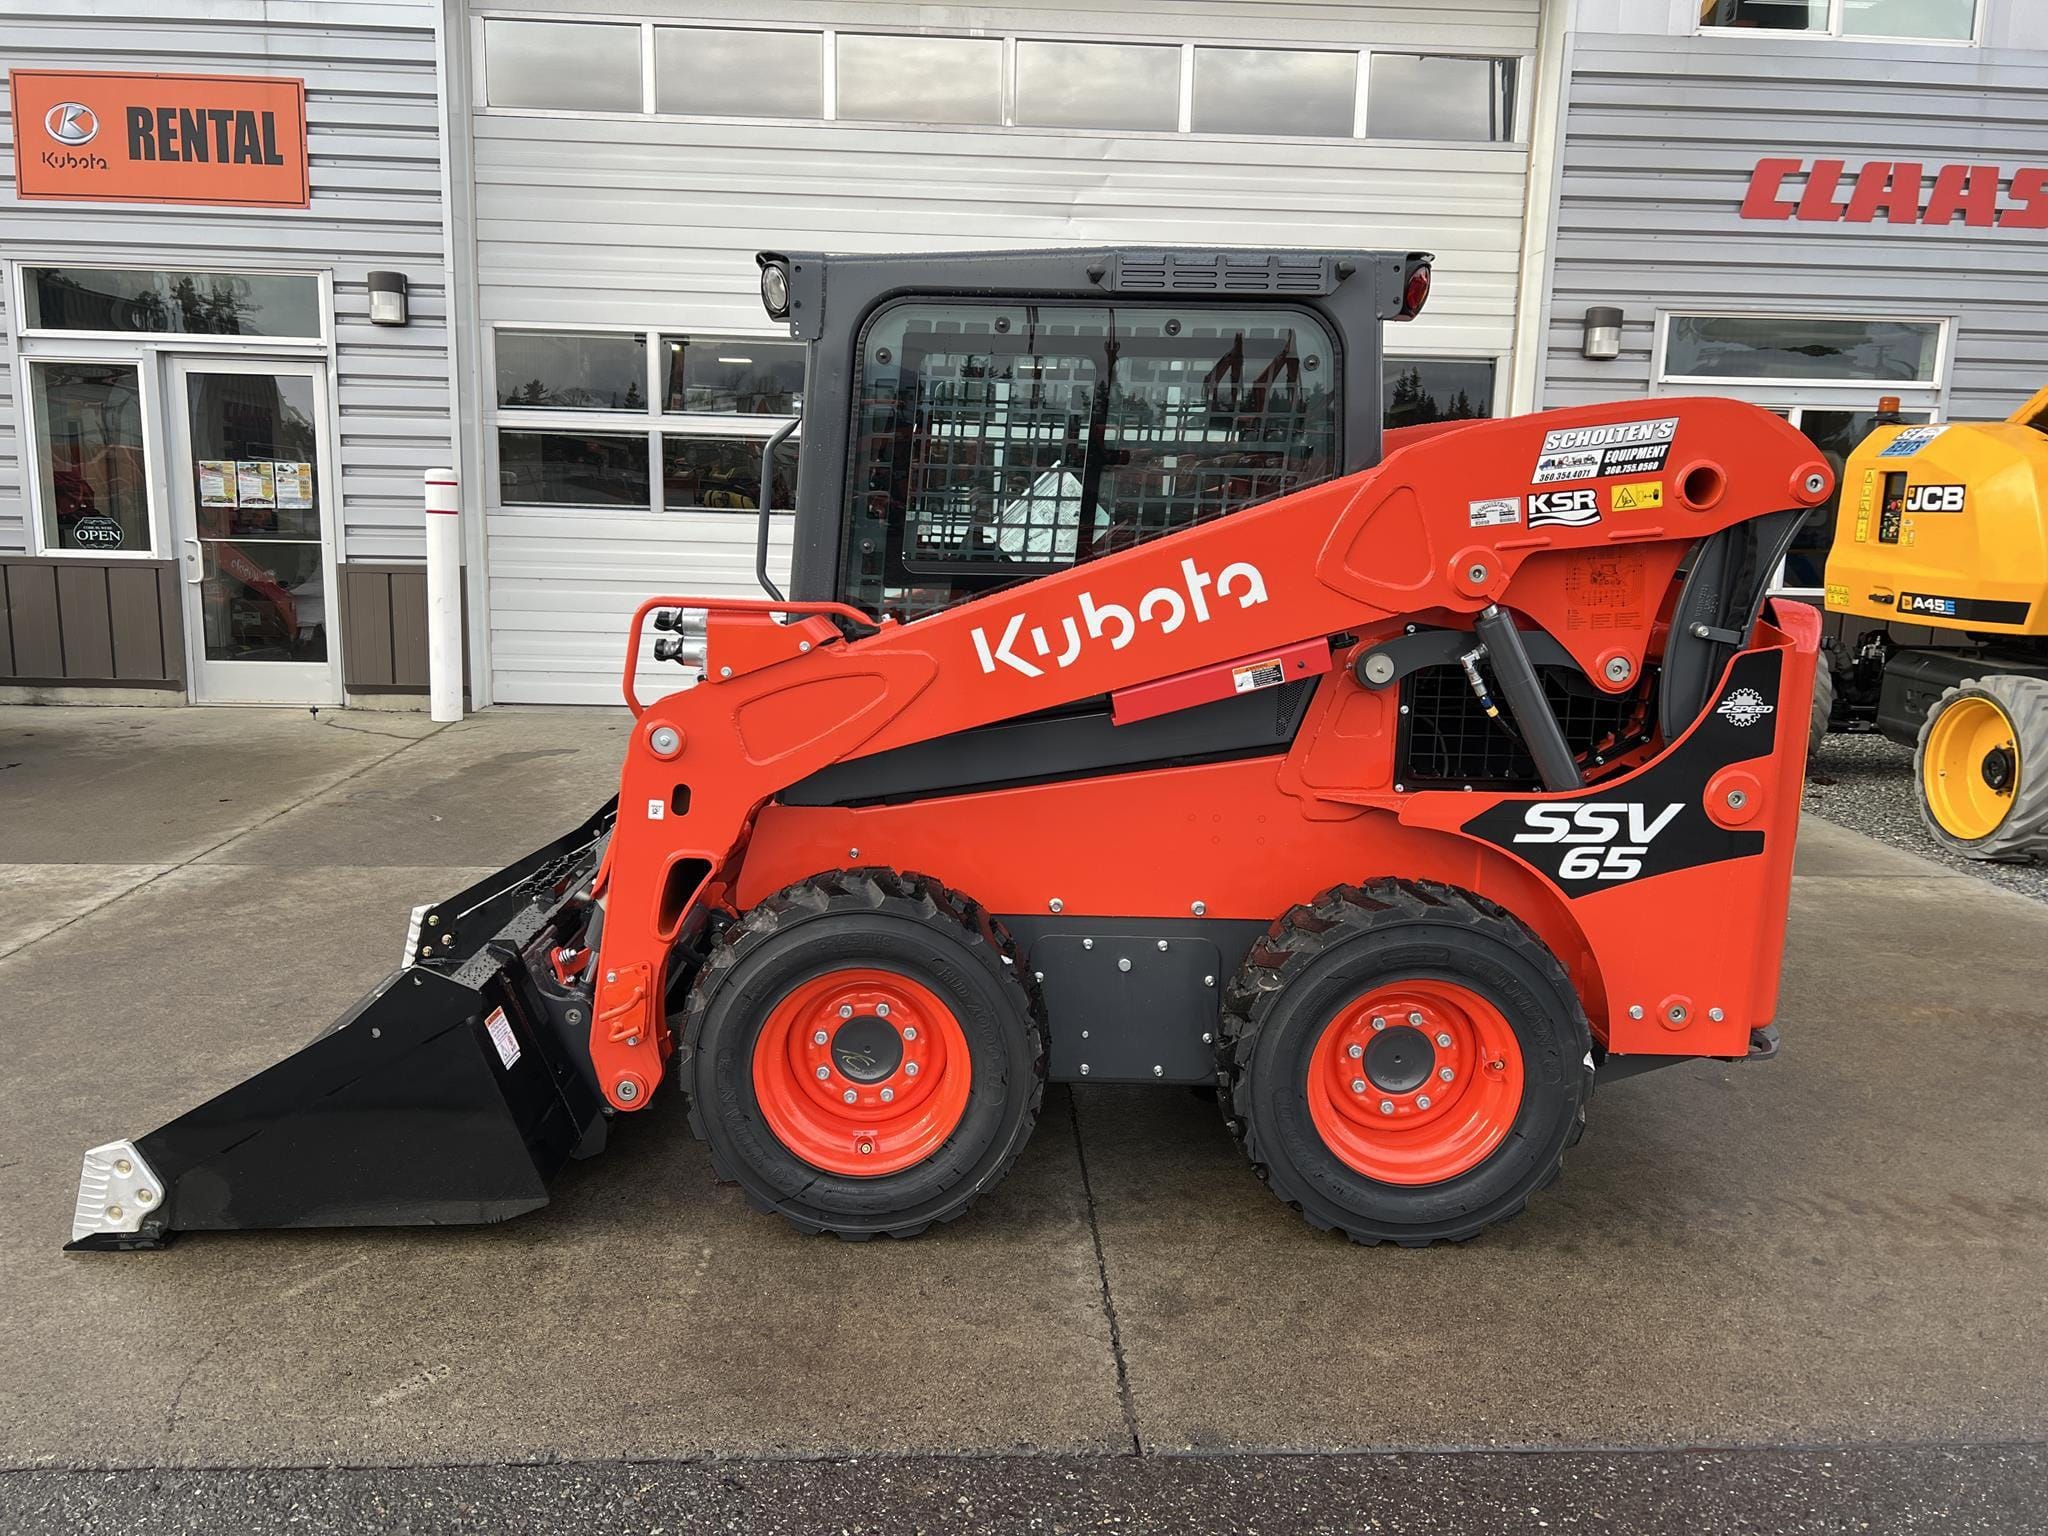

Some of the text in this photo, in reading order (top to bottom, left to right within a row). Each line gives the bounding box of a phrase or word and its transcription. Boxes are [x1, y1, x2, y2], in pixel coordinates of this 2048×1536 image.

[126, 106, 284, 165] RENTAL
[42, 151, 108, 170] Kubota
[1740, 158, 2048, 228] CLAAS
[1545, 421, 1674, 451] SCHOLTEN'S
[1604, 444, 1669, 463] EQUIPMENT
[1538, 469, 1591, 482] 360.354.4071
[1528, 489, 1597, 514] KSR
[1906, 486, 1965, 511] JCB
[76, 529, 121, 541] OPEN
[970, 557, 1269, 678] Kubota
[1913, 597, 1956, 613] A45E
[1512, 802, 1687, 844] SSV
[1558, 846, 1649, 880] 65
